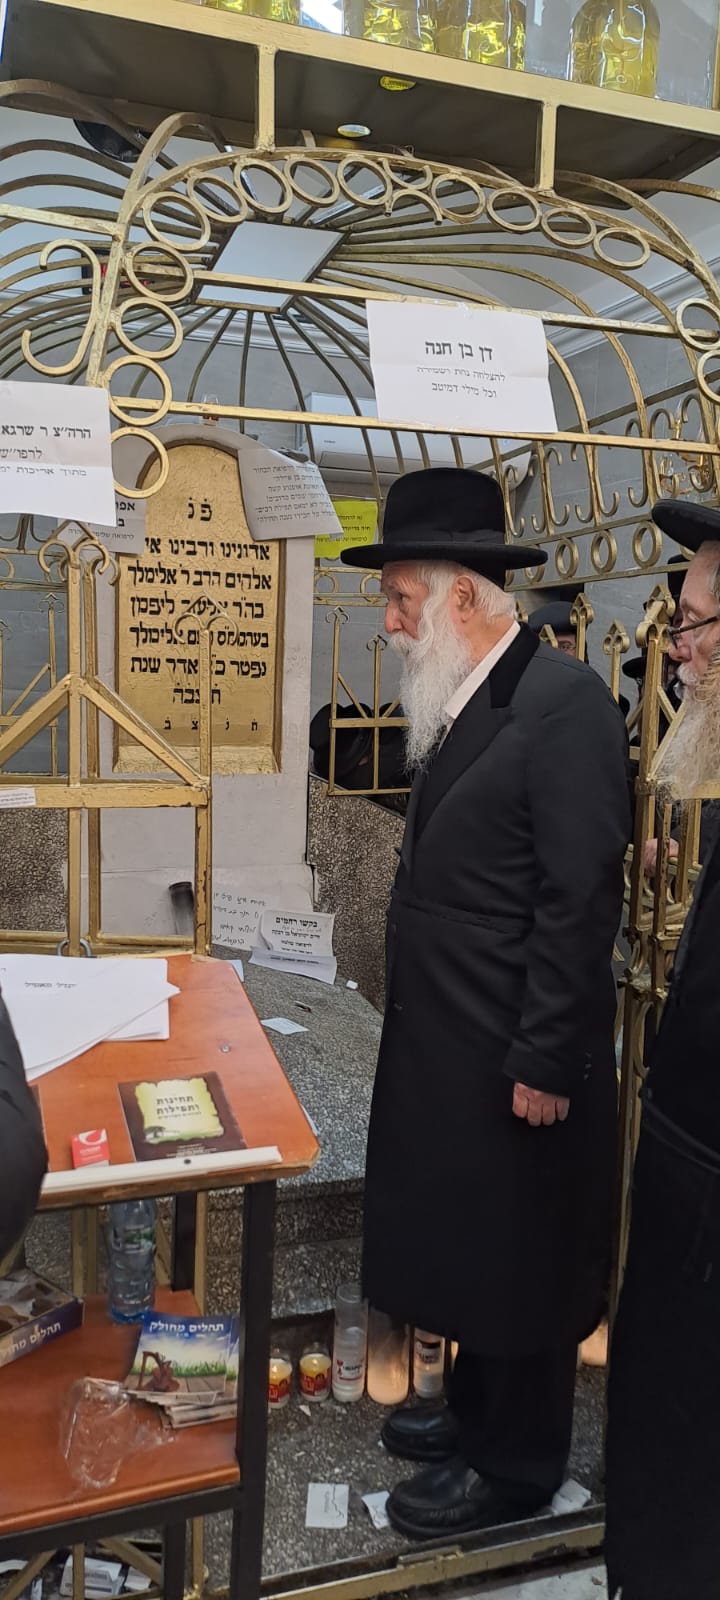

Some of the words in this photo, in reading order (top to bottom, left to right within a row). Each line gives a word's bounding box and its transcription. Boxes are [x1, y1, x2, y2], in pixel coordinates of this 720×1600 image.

[425, 340, 452, 356] חנה
[458, 342, 473, 359] בן
[479, 346, 493, 362] דן
[454, 368, 470, 377] נחת
[472, 370, 506, 382] להצלחה
[431, 382, 458, 393] דמיטב
[461, 384, 480, 396] מילי
[482, 388, 497, 398] וכל
[2, 425, 34, 436] שרגא
[40, 426, 48, 437] ר
[16, 466, 54, 475] אריכות
[168, 538, 214, 558] ורבינו
[220, 542, 270, 560] אדונינו
[128, 560, 177, 586] אלימלך
[192, 570, 220, 588] הרב
[225, 567, 272, 590] אלהים
[130, 590, 174, 617] ליפמן
[130, 656, 160, 673] שנת
[166, 658, 198, 674] אדר
[230, 660, 267, 678] נפטר
[275, 917, 298, 926] רחמים
[299, 919, 318, 929] בקשו
[156, 1096, 194, 1105] תחינות
[156, 1104, 200, 1114] ותפילות
[149, 1320, 186, 1333] מחולק
[189, 1322, 224, 1333] תהלים
